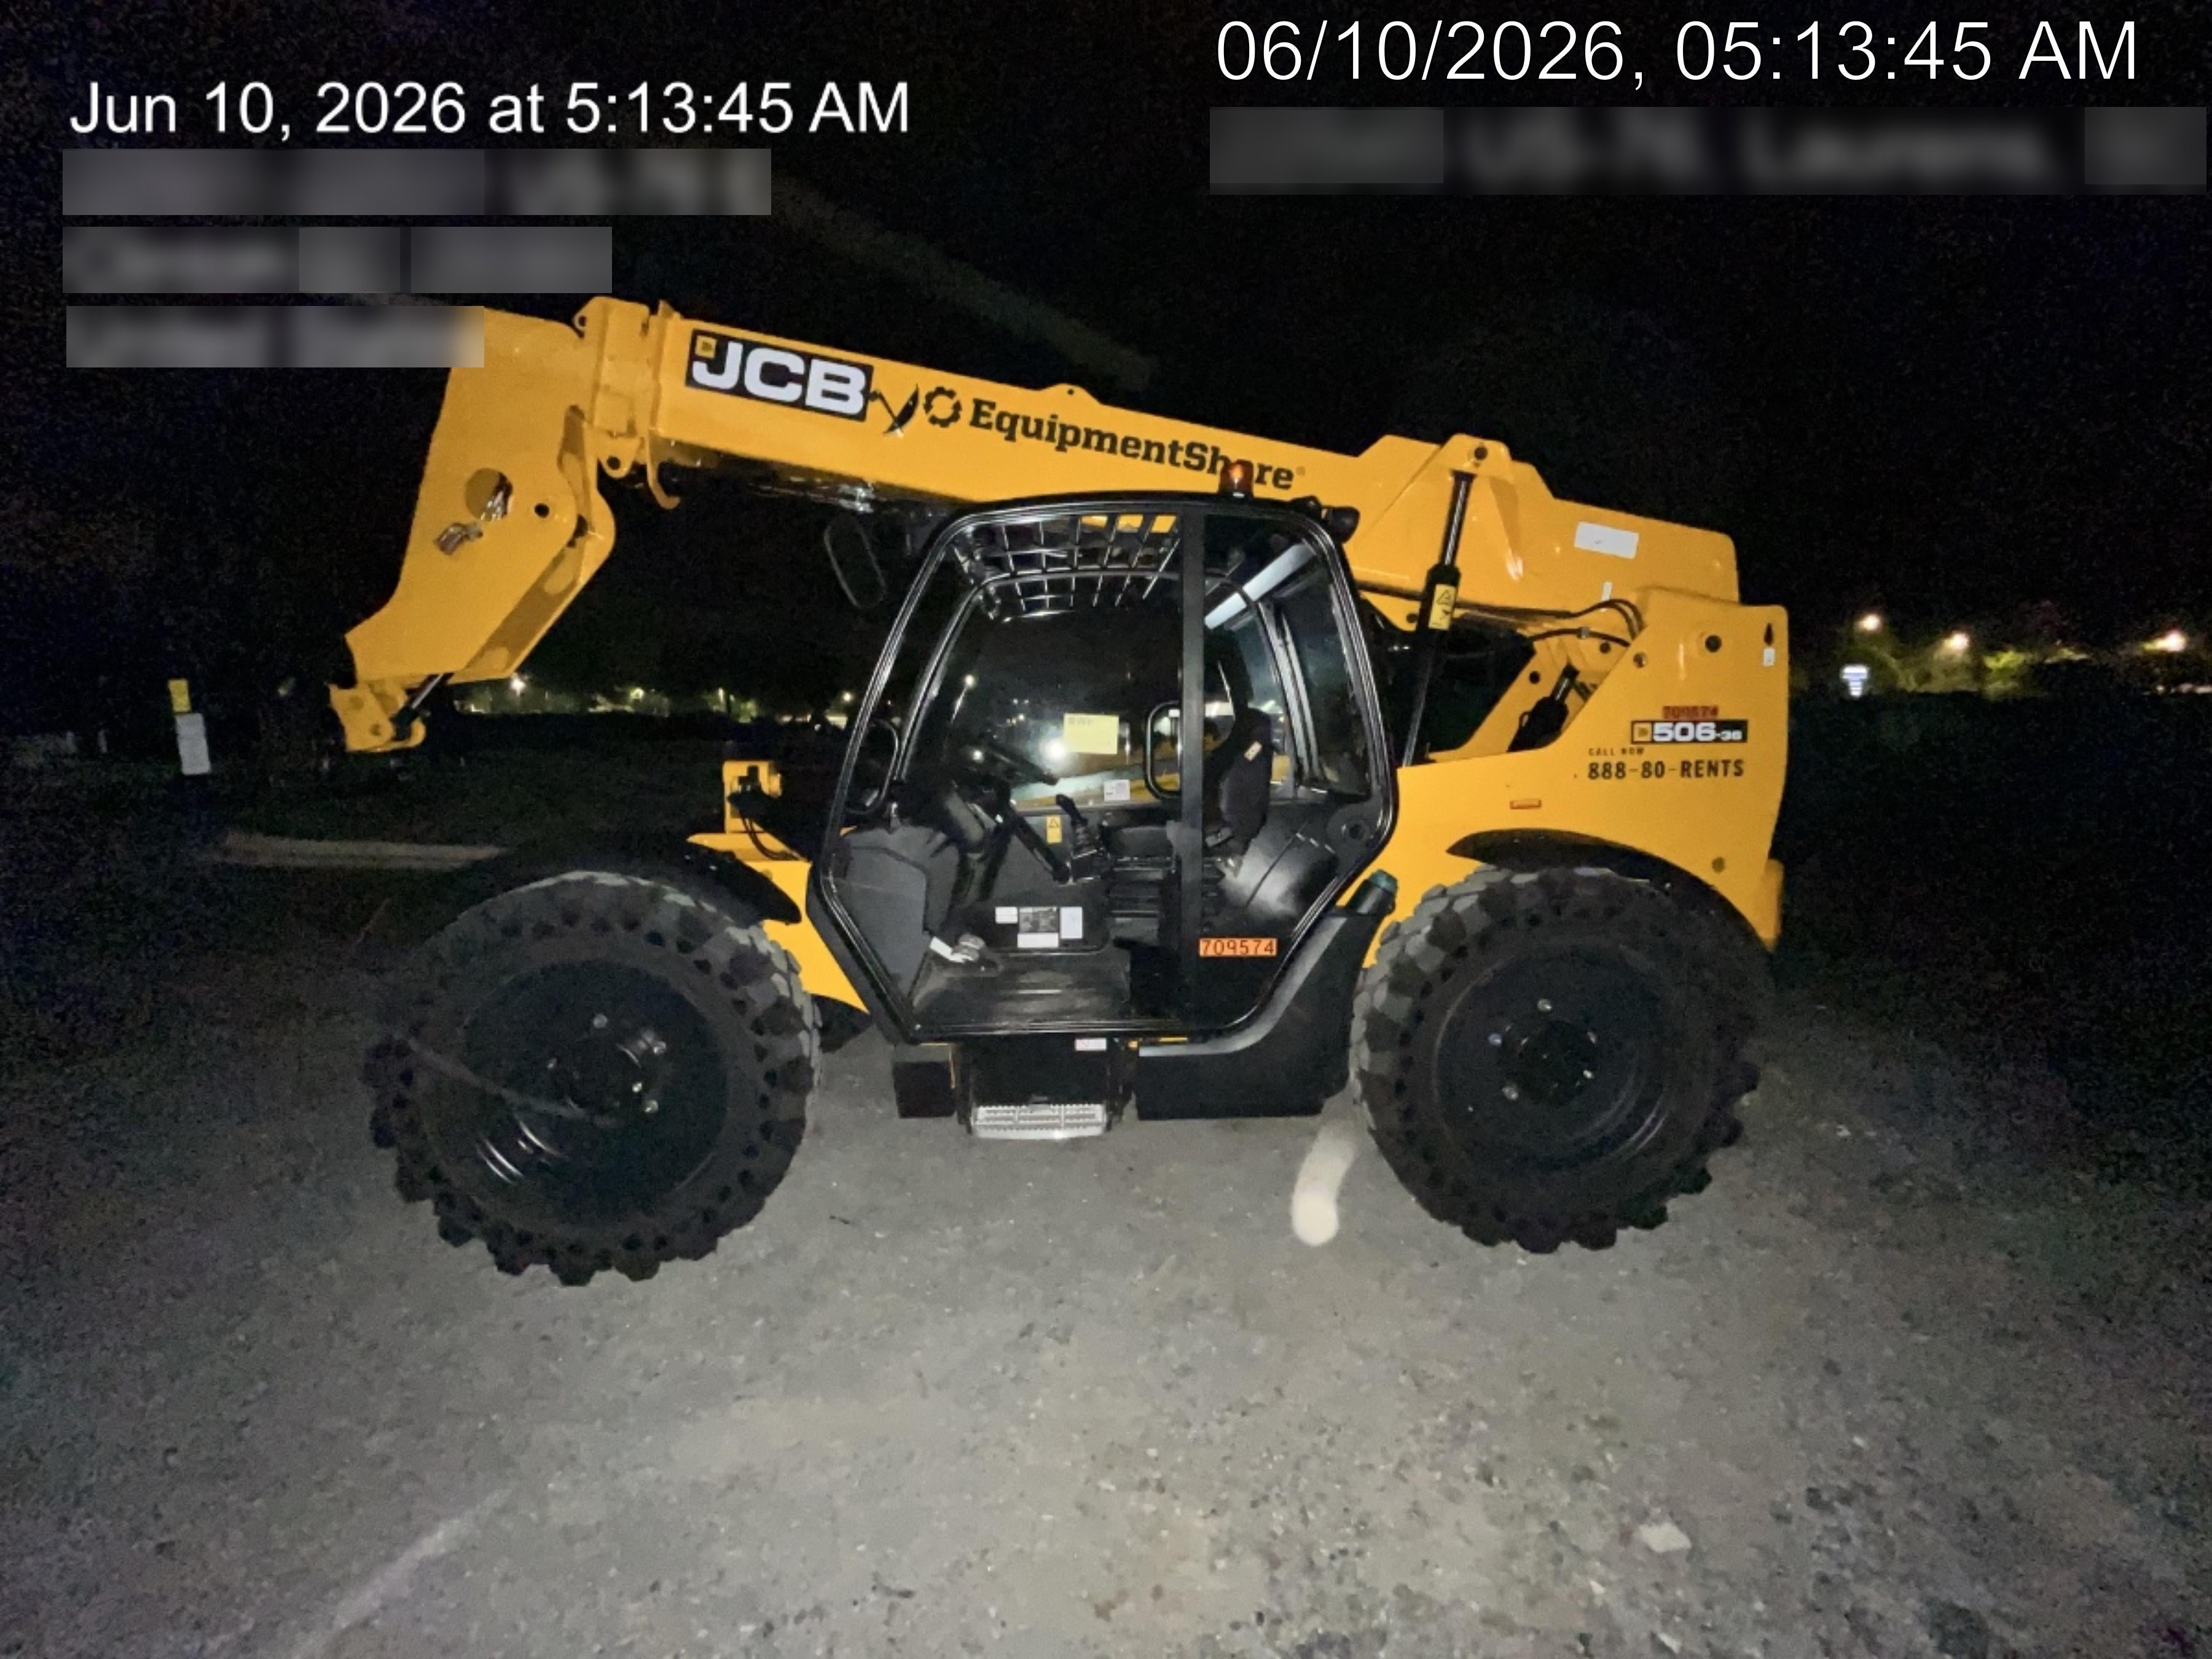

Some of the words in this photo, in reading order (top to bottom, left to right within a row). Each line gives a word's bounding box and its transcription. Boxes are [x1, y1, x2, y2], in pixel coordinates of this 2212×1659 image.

[692, 341, 866, 415] JCB
[970, 398, 1294, 490] EquipmentShre
[1588, 747, 1615, 756] CALL
[1201, 939, 1274, 955] 709574
